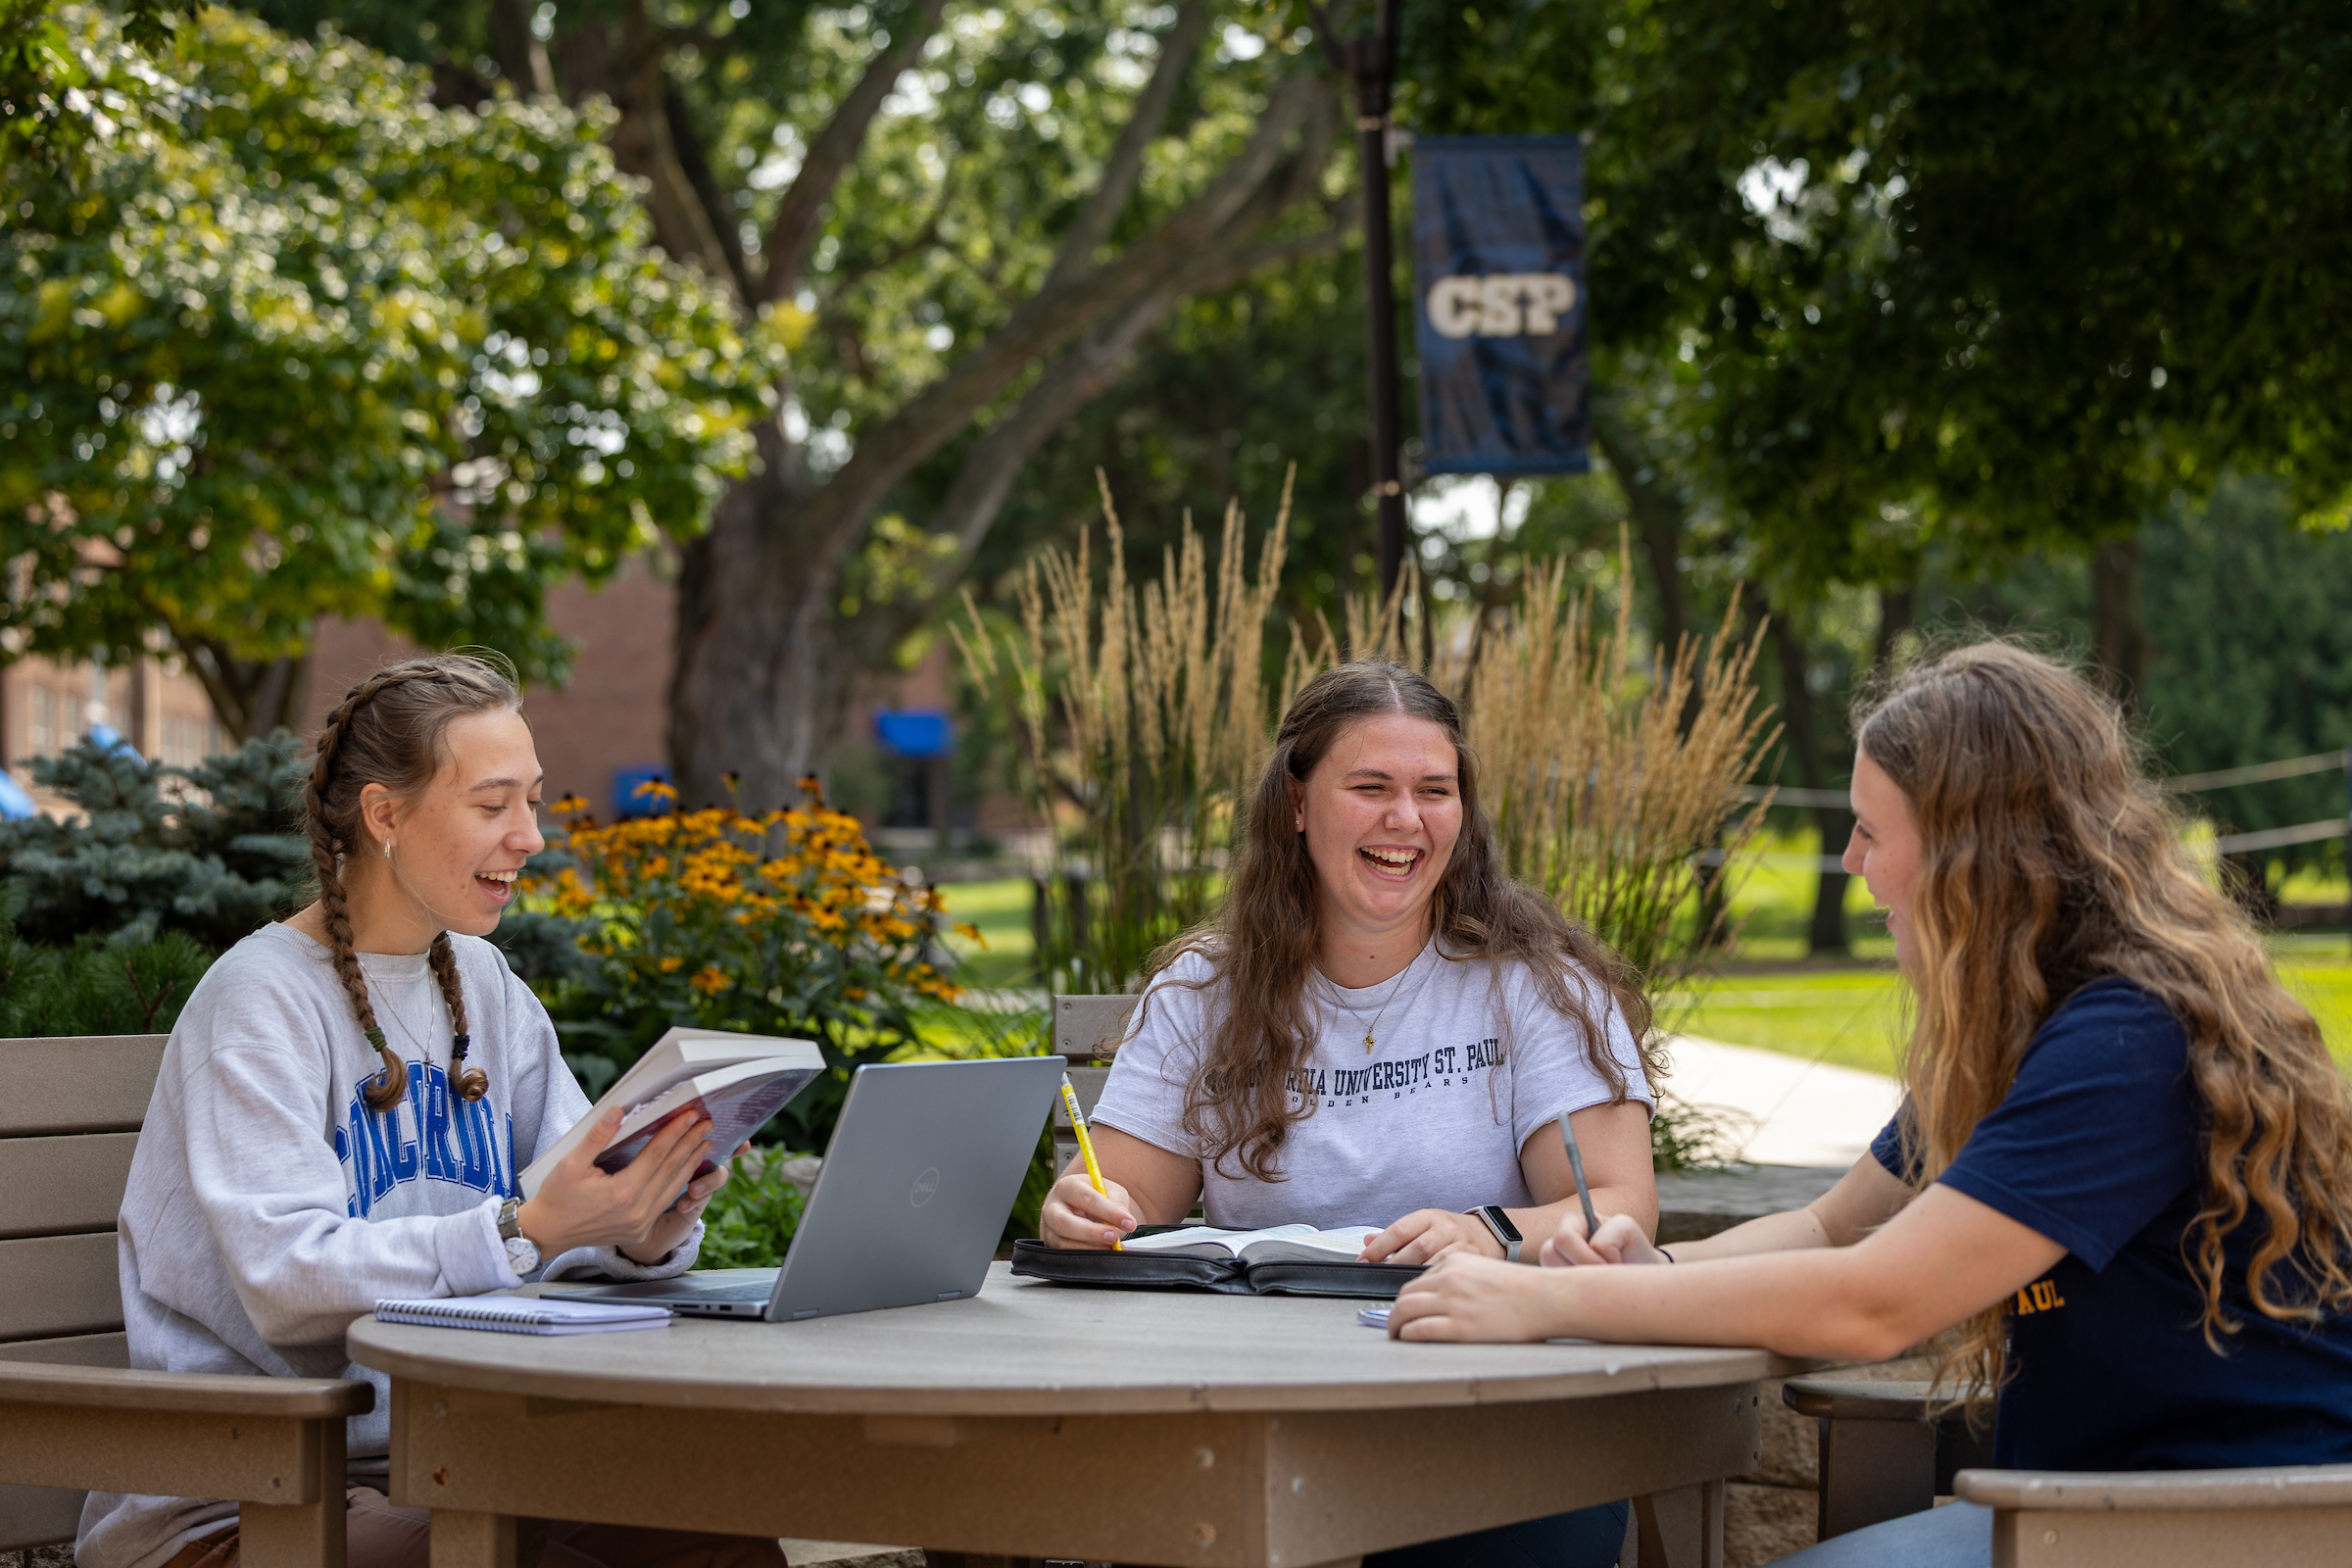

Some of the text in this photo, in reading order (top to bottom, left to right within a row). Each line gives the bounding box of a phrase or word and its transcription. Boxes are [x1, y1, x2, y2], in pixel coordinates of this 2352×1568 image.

[1427, 272, 1576, 339] CSP
[1334, 1053, 1430, 1096] UNIVERSITY
[1435, 1046, 1461, 1074] ST.
[1466, 1038, 1504, 1071] PAUL
[1394, 1076, 1468, 1100] BEARS
